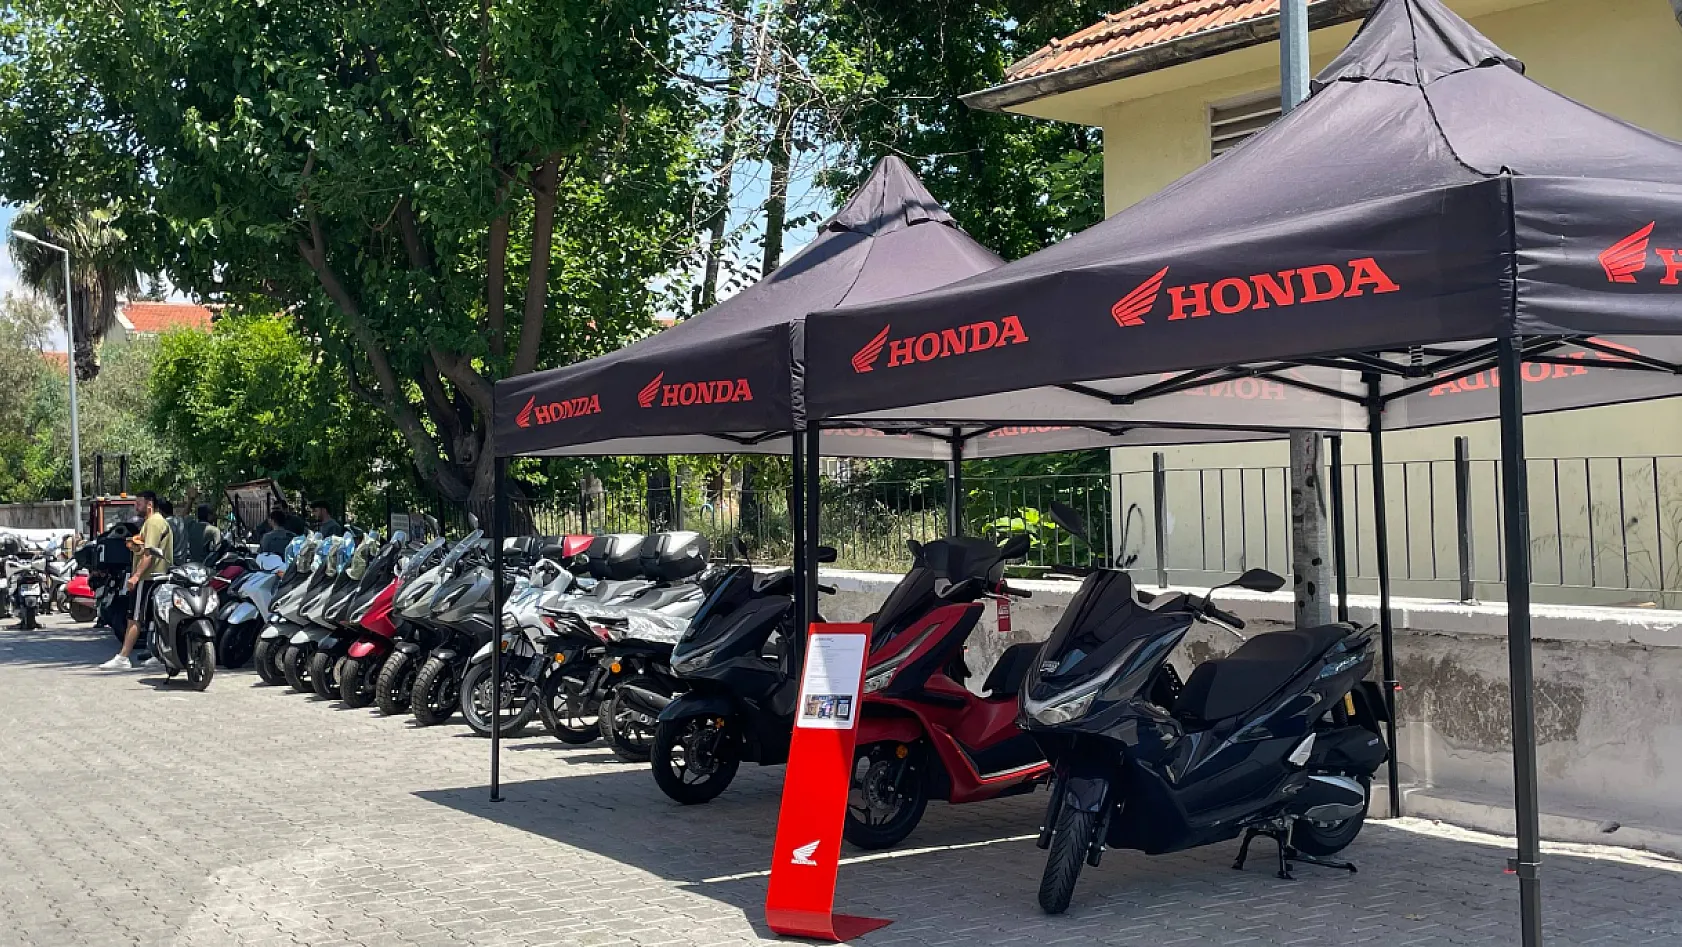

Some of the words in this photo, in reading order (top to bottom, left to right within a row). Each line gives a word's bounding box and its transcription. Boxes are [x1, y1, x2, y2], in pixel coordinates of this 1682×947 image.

[1166, 256, 1401, 321] HONDA
[887, 315, 1029, 368] HONDA
[533, 394, 601, 425] HONDA
[661, 378, 753, 407] HONDA
